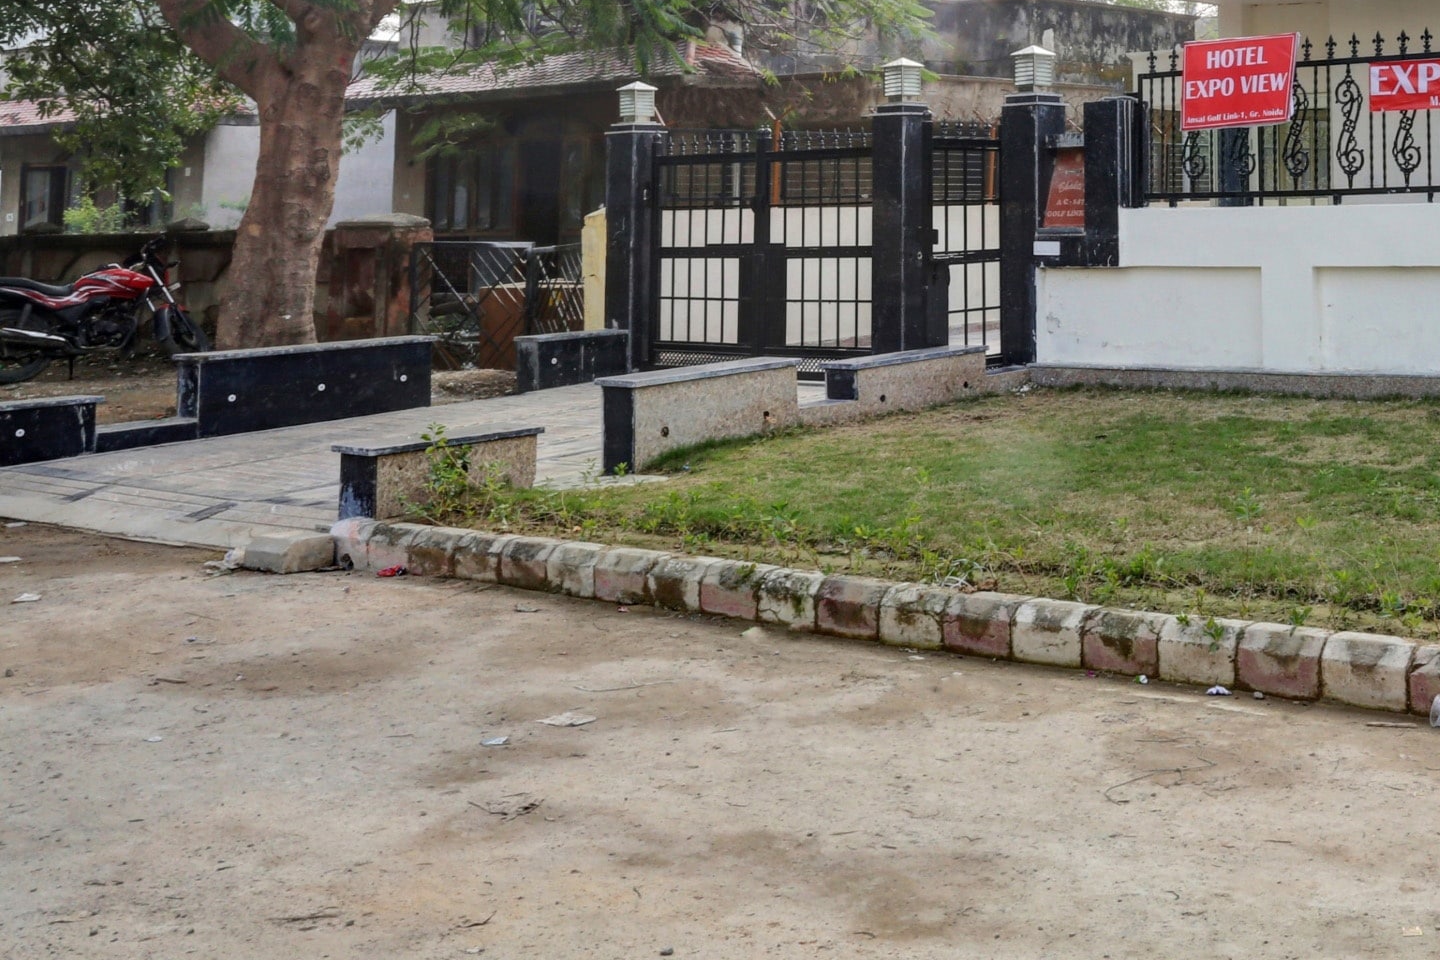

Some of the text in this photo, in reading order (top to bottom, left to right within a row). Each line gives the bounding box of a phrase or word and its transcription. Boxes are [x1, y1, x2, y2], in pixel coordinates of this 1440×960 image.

[1206, 46, 1268, 69] HOTEL
[1185, 72, 1288, 100] EXPO VIEW
[1263, 108, 1284, 116] Noida
